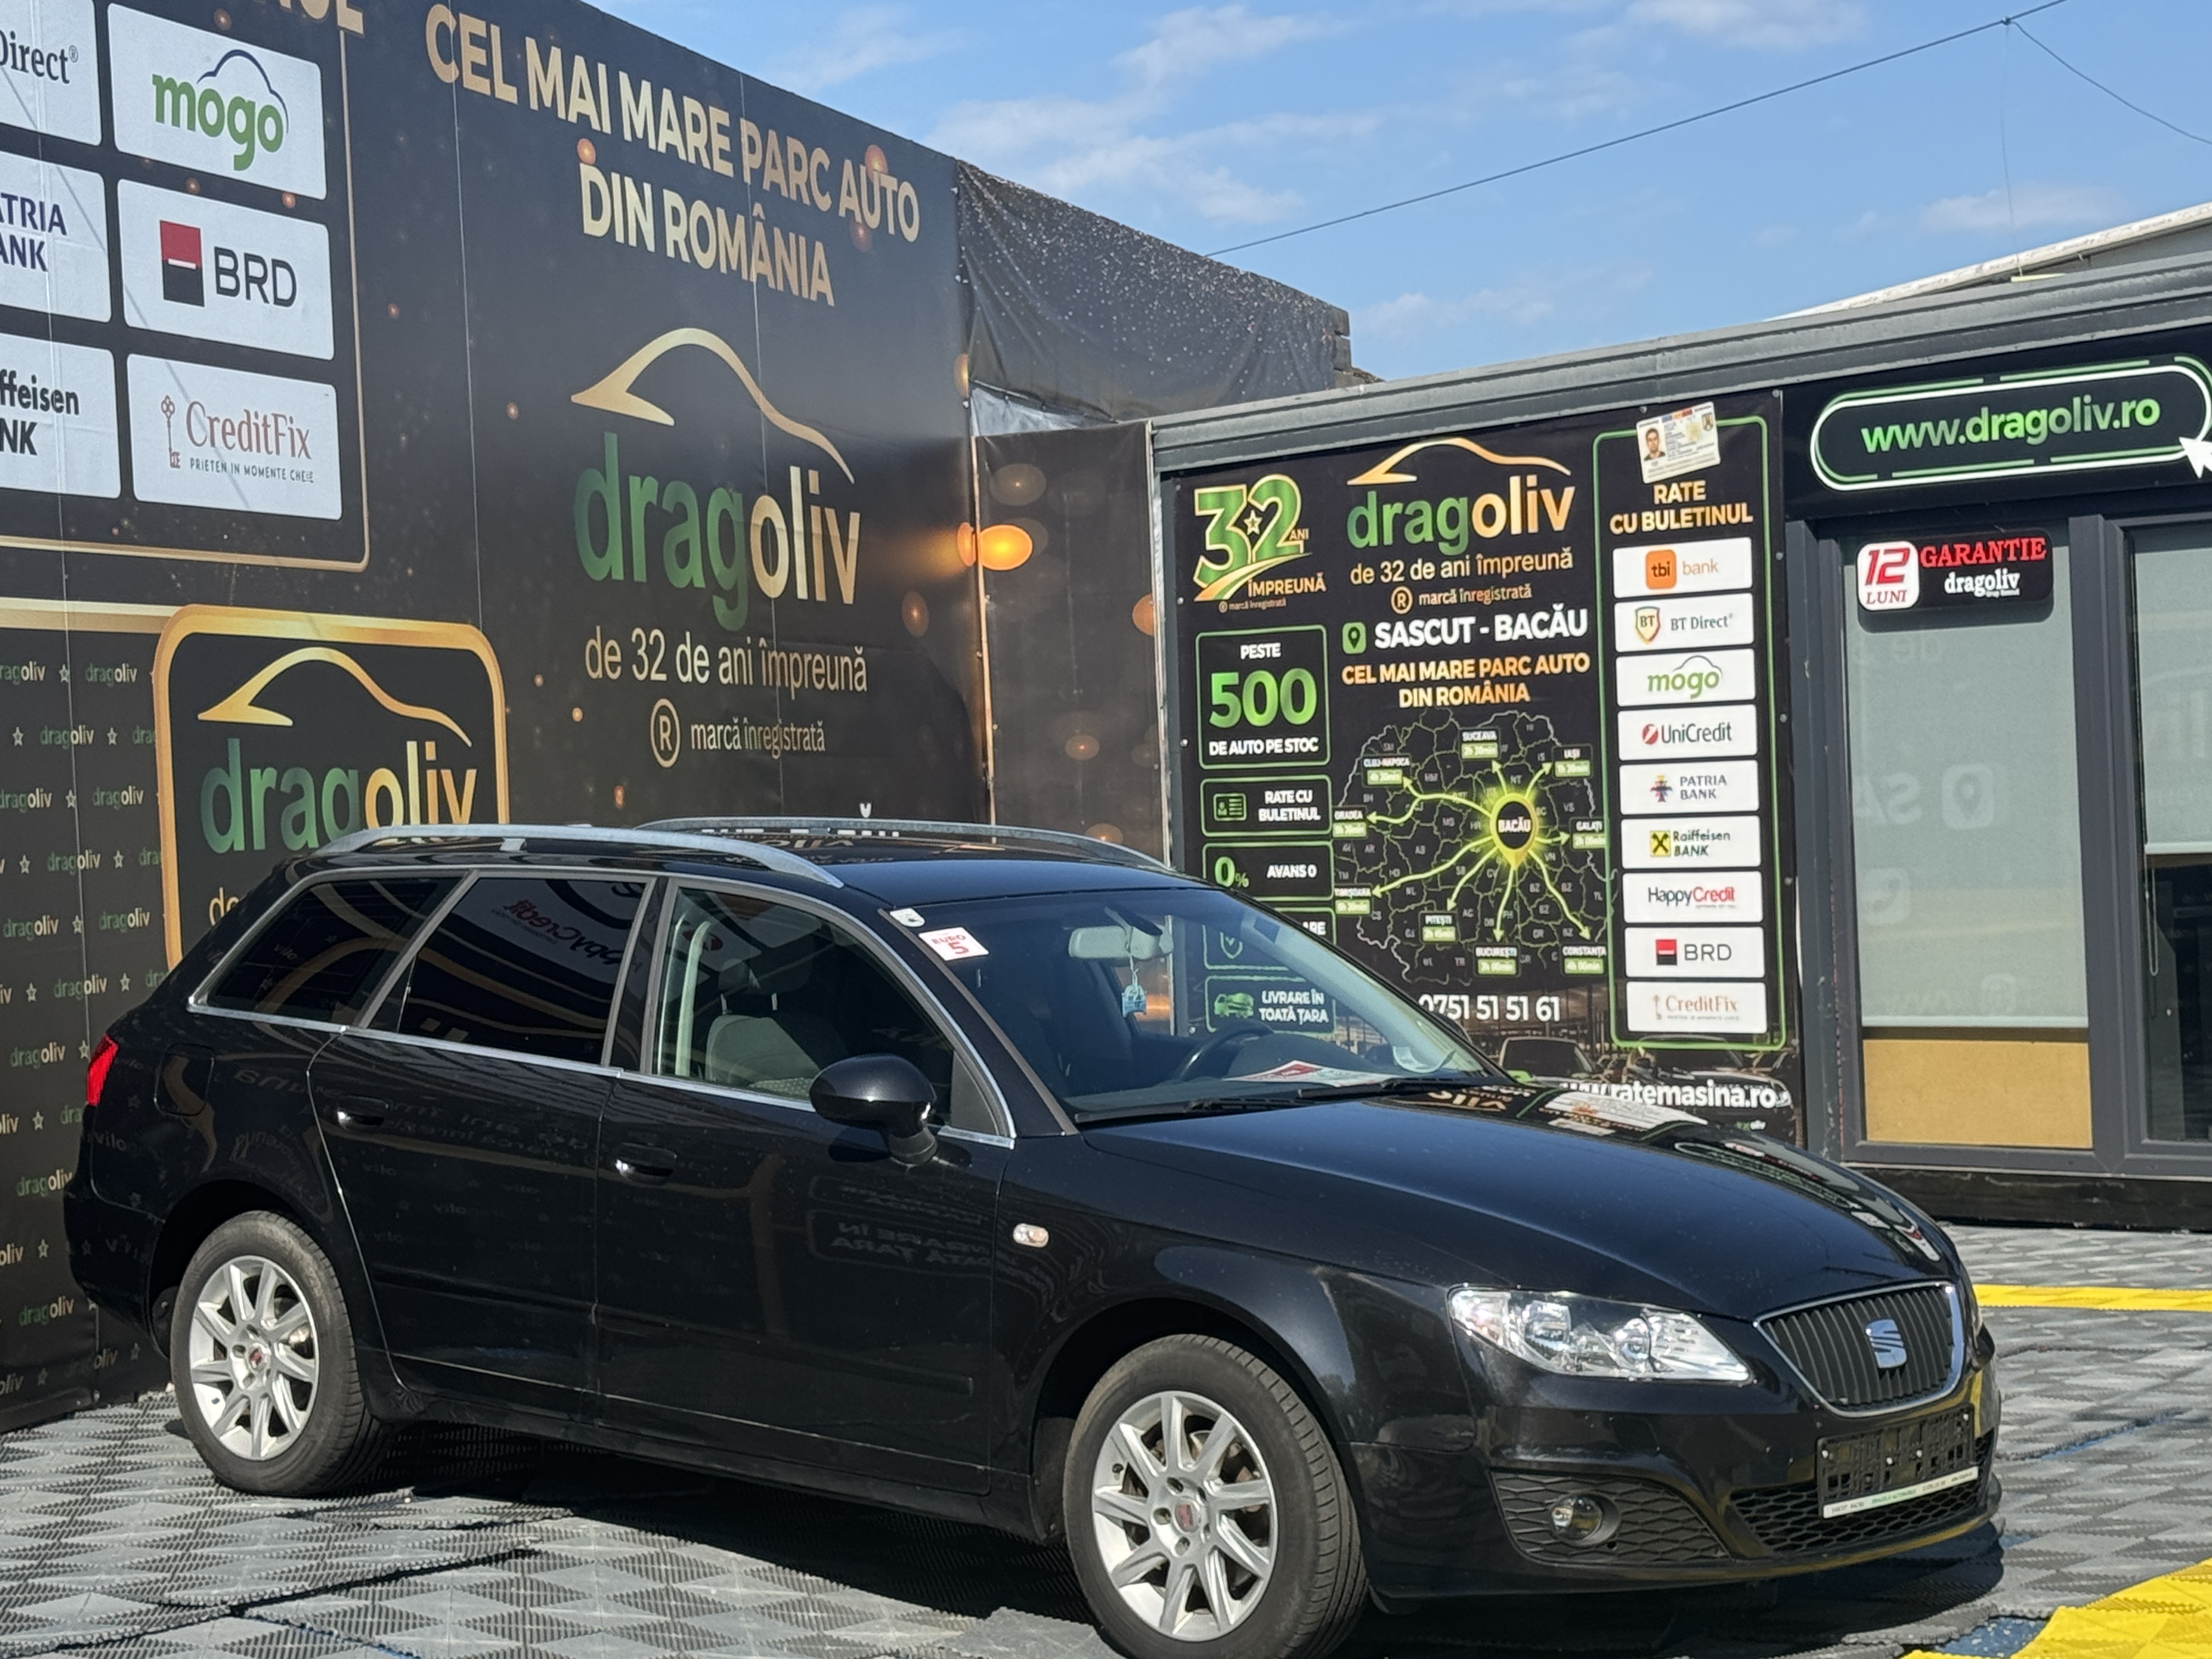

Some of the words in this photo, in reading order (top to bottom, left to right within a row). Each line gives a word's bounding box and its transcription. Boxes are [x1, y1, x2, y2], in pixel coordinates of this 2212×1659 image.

[152, 74, 284, 171] mogo
[426, 4, 518, 104] CEL
[525, 36, 611, 134] MAI
[618, 70, 733, 177] MARE
[740, 118, 832, 212] PARC
[838, 159, 919, 242] AUTO
[0, 193, 67, 236] TRIA
[579, 162, 656, 253] DIN
[662, 188, 835, 307] ROMÂNIA
[214, 246, 297, 307] BRD
[186, 400, 312, 460] CreditFix
[1861, 394, 2160, 453] www.dragoliv.ro
[190, 458, 227, 473] PRIETEN
[244, 465, 286, 481] MOMENTE
[1654, 481, 1706, 504] RATE
[1347, 474, 1575, 556] dragoliv
[1610, 513, 1638, 535] CU
[1641, 503, 1754, 532] BULETINUL
[574, 431, 860, 631] dragoliv
[1193, 475, 1304, 587] 32
[1289, 528, 1309, 540] ANI
[1921, 537, 2047, 567] GARANTIE
[1350, 563, 1375, 585] de
[1380, 560, 1405, 583] 32
[1410, 558, 1436, 581] de
[1440, 554, 1470, 578] ani
[1476, 546, 1573, 579] împreună
[1651, 561, 1671, 578] tbi
[1682, 558, 1719, 575] bank
[1865, 548, 1910, 585] 12
[1419, 588, 1457, 606] marcă
[1459, 583, 1532, 605] înregistrată
[1945, 568, 2021, 597] dragoliv
[1866, 590, 1908, 604] LUNI
[1374, 616, 1476, 649] SASCUT
[1494, 602, 1588, 641] BACĂU
[1640, 615, 1655, 628] BT
[1671, 617, 1687, 631] BT
[585, 625, 622, 680] de
[631, 627, 668, 682] 32
[676, 631, 710, 684] de
[718, 636, 753, 686] ani
[759, 637, 867, 701] împreună
[1240, 642, 1281, 659] PESTE
[85, 663, 137, 687] dragoliv
[1341, 665, 1377, 685] CEL
[1379, 662, 1415, 683] MAI
[1419, 658, 1476, 681] MARE
[1480, 656, 1532, 678] PARC
[1534, 652, 1591, 675] AUTO
[1399, 687, 1432, 708] DIN
[1436, 680, 1531, 706] ROMÂNIA
[1647, 670, 1720, 699] mogo
[1209, 668, 1317, 728] 500
[40, 725, 94, 749] dragoliv
[691, 716, 742, 751] marcă
[744, 717, 826, 760] înregistrată
[1662, 722, 1732, 743] UniCredit
[1209, 741, 1228, 755] DE
[1229, 740, 1265, 755] AUTO
[1266, 738, 1283, 754] PE
[1284, 737, 1319, 752] STOC
[1680, 775, 1727, 787] PATRIA
[1680, 788, 1717, 800] BANK
[92, 785, 144, 810] dragoliv
[200, 738, 477, 854] dragoliv
[1265, 790, 1295, 804] RATE
[1295, 790, 1313, 803] CU
[1258, 807, 1321, 821] BULETINUL
[1498, 816, 1531, 833] BACĂU
[1673, 829, 1730, 842] Raiffeisen
[47, 850, 101, 876] dragoliv
[1674, 845, 1709, 856] BANK
[1267, 865, 1307, 878] AVANS
[1307, 864, 1317, 877] 0
[1648, 886, 1735, 907] HappyCredit
[3, 915, 59, 941] dragoliv
[99, 907, 150, 932] dragoliv
[931, 934, 966, 944] EURO
[948, 942, 969, 955] 5
[1684, 944, 1732, 961] BRD
[54, 974, 107, 1000] dragoliv
[1262, 990, 1310, 1005] LIVRARE
[1476, 995, 1499, 1020] 51
[1505, 995, 1529, 1021] 51
[1536, 996, 1560, 1022] 61
[1666, 995, 1737, 1012] CreditFix
[10, 1042, 65, 1069] dragoliv
[17, 1169, 72, 1197] dragoliv
[19, 1296, 75, 1325] dragoliv
